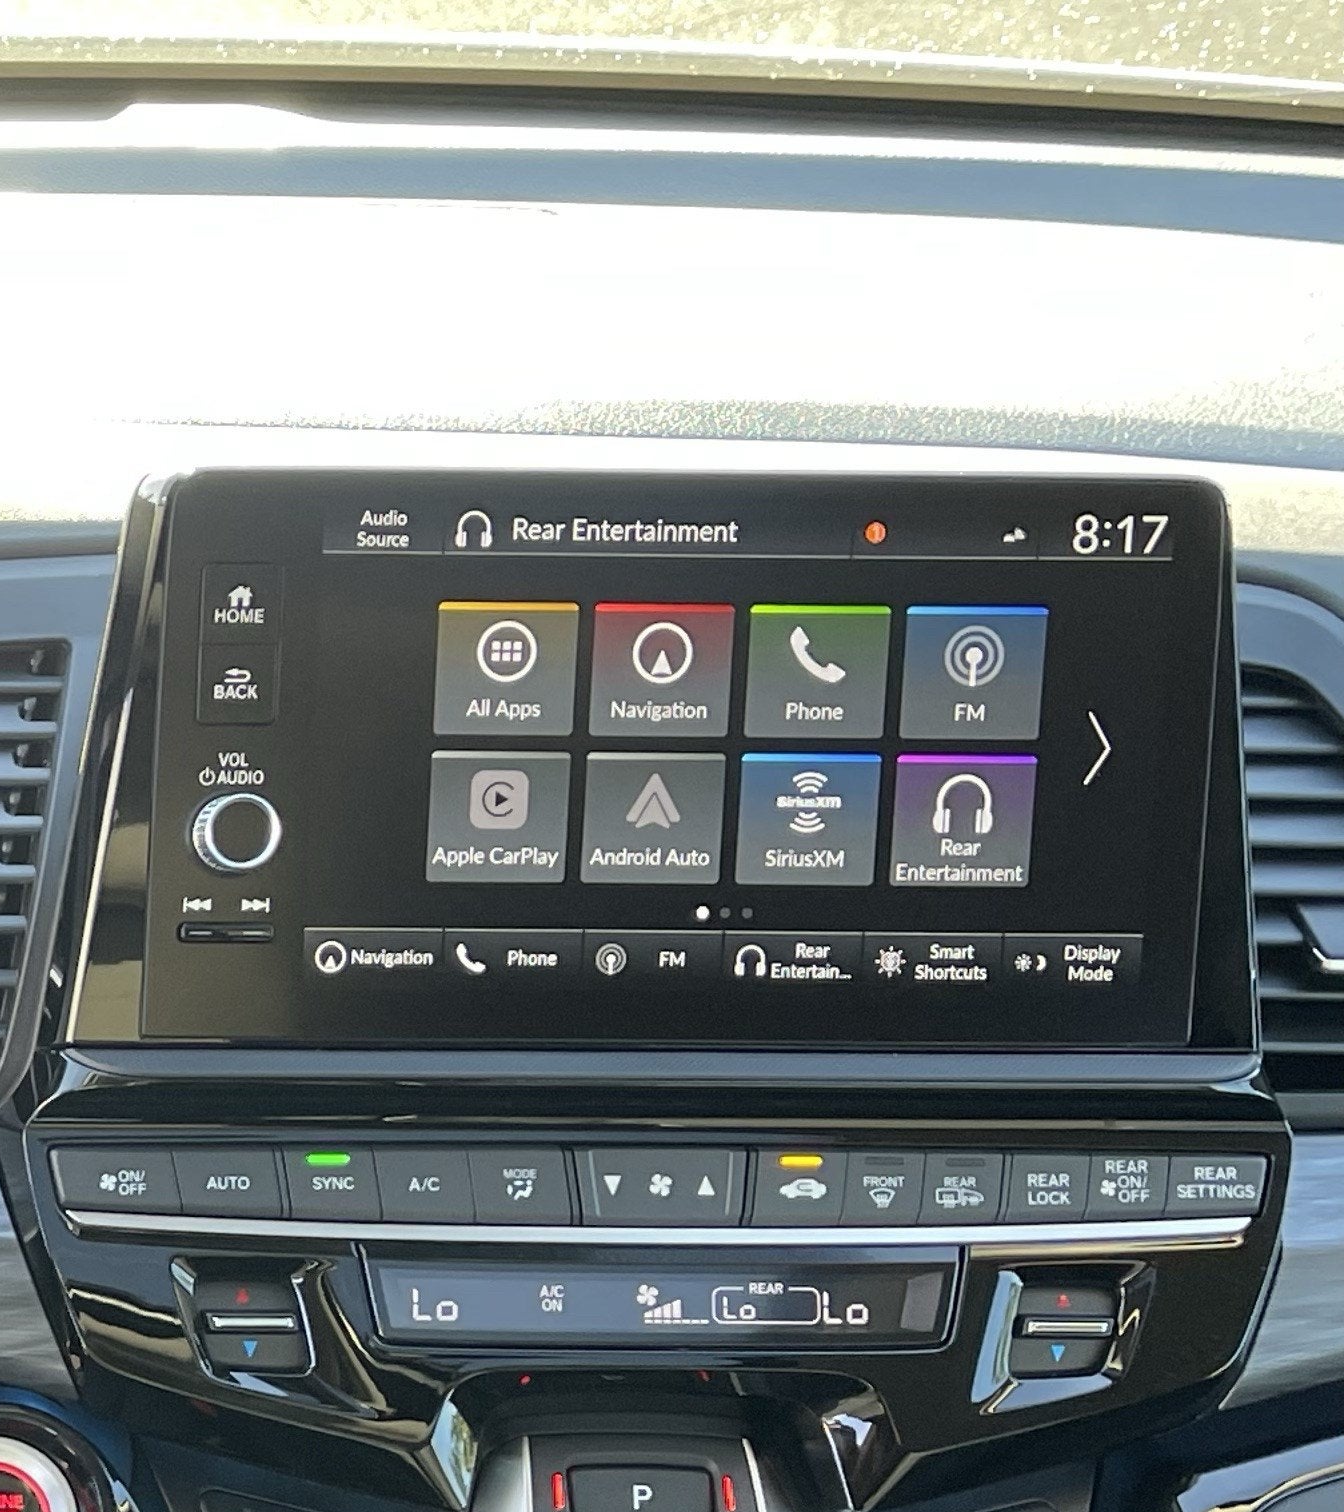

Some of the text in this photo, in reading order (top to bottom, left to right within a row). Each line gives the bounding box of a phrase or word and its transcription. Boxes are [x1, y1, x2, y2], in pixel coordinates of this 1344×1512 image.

[360, 510, 408, 528] Audio
[511, 517, 739, 544] Rear Entertainment
[1071, 513, 1170, 555] 8:17
[356, 532, 410, 549] Source
[214, 608, 266, 625] HOME
[213, 685, 258, 700] BACK
[465, 699, 542, 720] All Apps
[610, 700, 708, 722] Navigation
[785, 702, 845, 722] Phone
[954, 704, 986, 722] FM
[218, 752, 250, 768] VOL
[216, 770, 265, 786] AUDIO
[940, 838, 982, 857] Rear
[431, 846, 560, 869] Apple CarPlay
[589, 847, 711, 867] Android Auto
[764, 848, 845, 868] SiriusXM
[895, 863, 1024, 883] Entertainment
[350, 947, 434, 967] Navigation
[506, 949, 558, 967] Phone
[658, 950, 686, 968] FM
[794, 942, 831, 959] Rear
[929, 943, 976, 961] Smart
[1063, 943, 1121, 964] Display
[914, 963, 988, 982] Shortcuts
[1067, 964, 1114, 982] Mode
[502, 1168, 538, 1181] MODE
[1104, 1159, 1149, 1175] REAR
[1193, 1166, 1238, 1182] REAR
[117, 1168, 147, 1184] ON/
[205, 1175, 251, 1191] AUTO
[311, 1175, 356, 1192] SYNC
[408, 1176, 442, 1193] A/C
[862, 1175, 906, 1188] FRONT
[943, 1176, 977, 1188] REAR
[1026, 1173, 1071, 1188] REAR
[1116, 1174, 1148, 1189] ON/
[117, 1182, 147, 1196] OFF
[1117, 1188, 1151, 1204] OFF
[1176, 1184, 1257, 1200] SETTINGS
[1027, 1190, 1071, 1206] LOCK
[538, 1283, 565, 1299] A/C
[748, 1282, 785, 1296] REAR
[412, 1288, 459, 1322] Lo
[541, 1298, 564, 1313] ON
[631, 1485, 653, 1510] P
